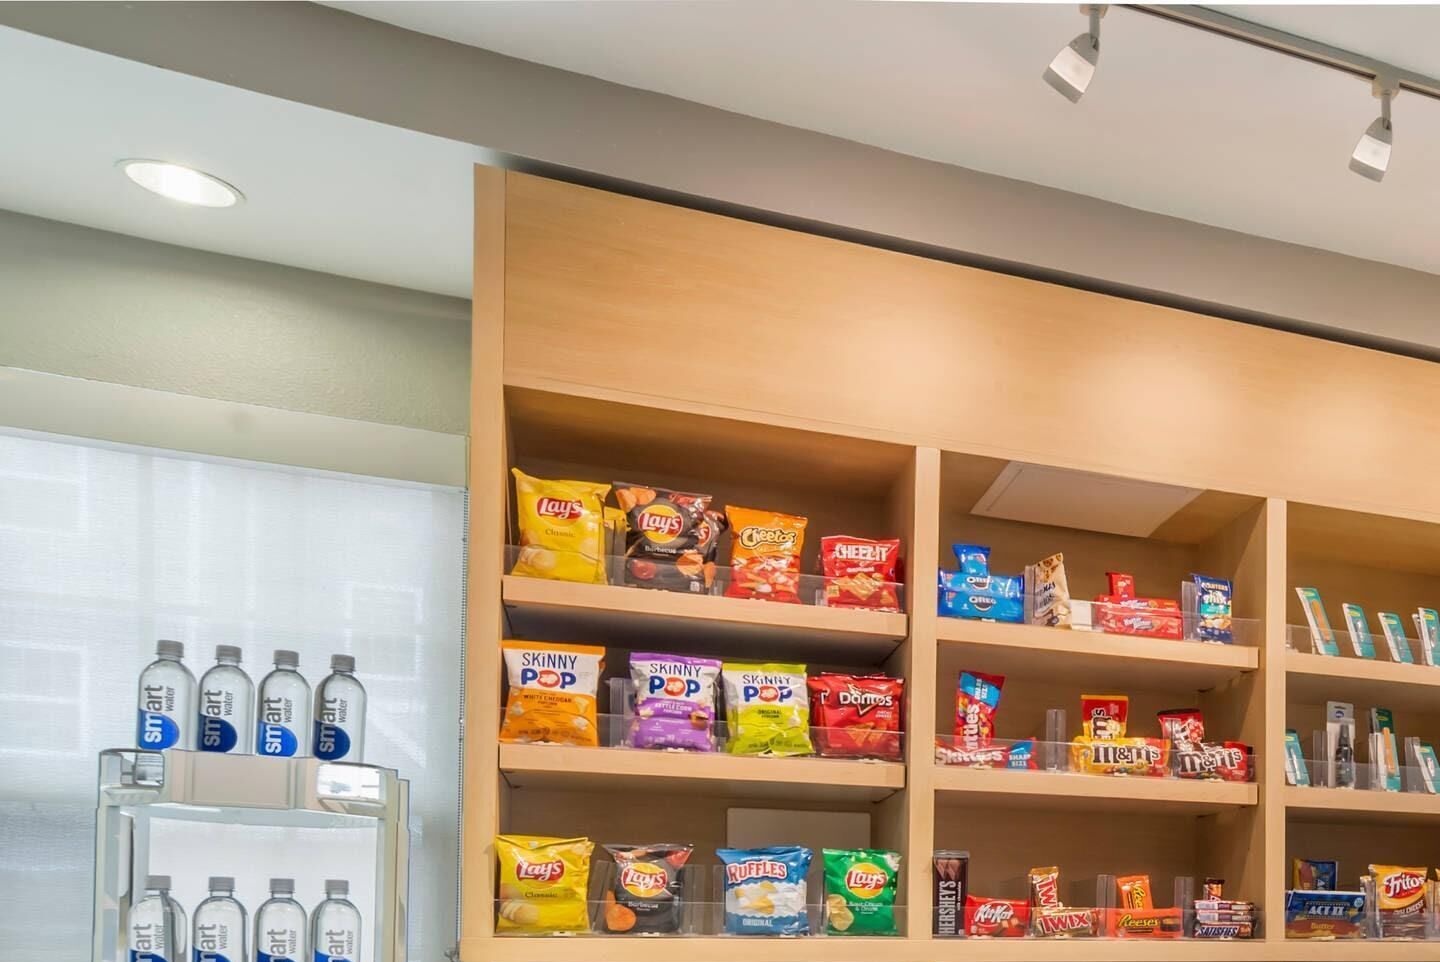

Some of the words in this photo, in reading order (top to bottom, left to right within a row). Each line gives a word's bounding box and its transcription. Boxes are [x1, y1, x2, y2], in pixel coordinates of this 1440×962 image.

[540, 497, 582, 519] Lay's
[641, 512, 680, 534] Lay's
[740, 527, 796, 549] Cheetos
[969, 596, 996, 604] OREO
[521, 668, 576, 689] POP
[649, 675, 701, 697] POP
[744, 685, 792, 702] POP
[839, 690, 893, 707] Doritos
[144, 684, 163, 743] smart
[204, 689, 222, 748] smart
[319, 697, 337, 752] smart
[266, 697, 282, 753] smart
[519, 860, 562, 882] Lay's
[625, 869, 665, 889] Lay's
[727, 861, 787, 884] RUFFLES
[849, 871, 885, 889] Lay's
[1384, 872, 1425, 897] Fritos
[938, 880, 956, 934] HERSHEY'S
[1309, 905, 1330, 915] ACT
[1040, 911, 1090, 933] TWIX
[1199, 926, 1239, 937] SATISFIES
